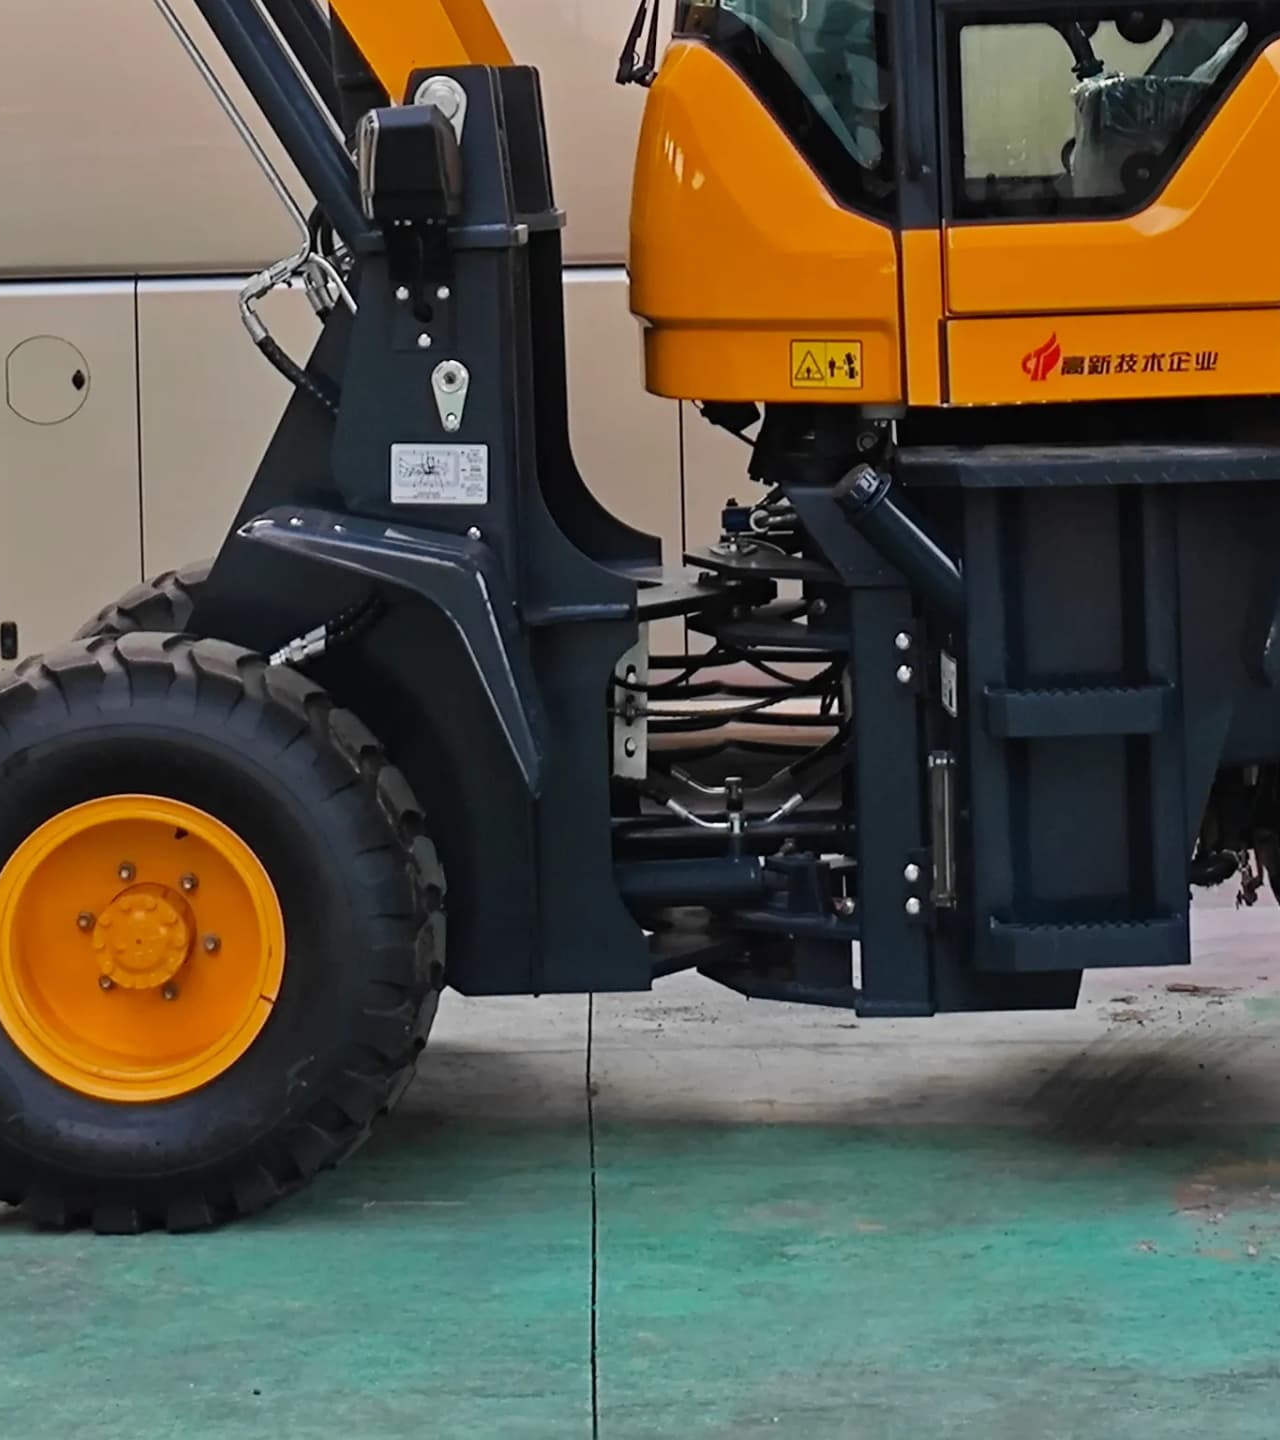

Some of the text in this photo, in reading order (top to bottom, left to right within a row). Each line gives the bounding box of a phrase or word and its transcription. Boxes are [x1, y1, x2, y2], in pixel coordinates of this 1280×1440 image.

[1060, 350, 1219, 377] 高新技术企业
